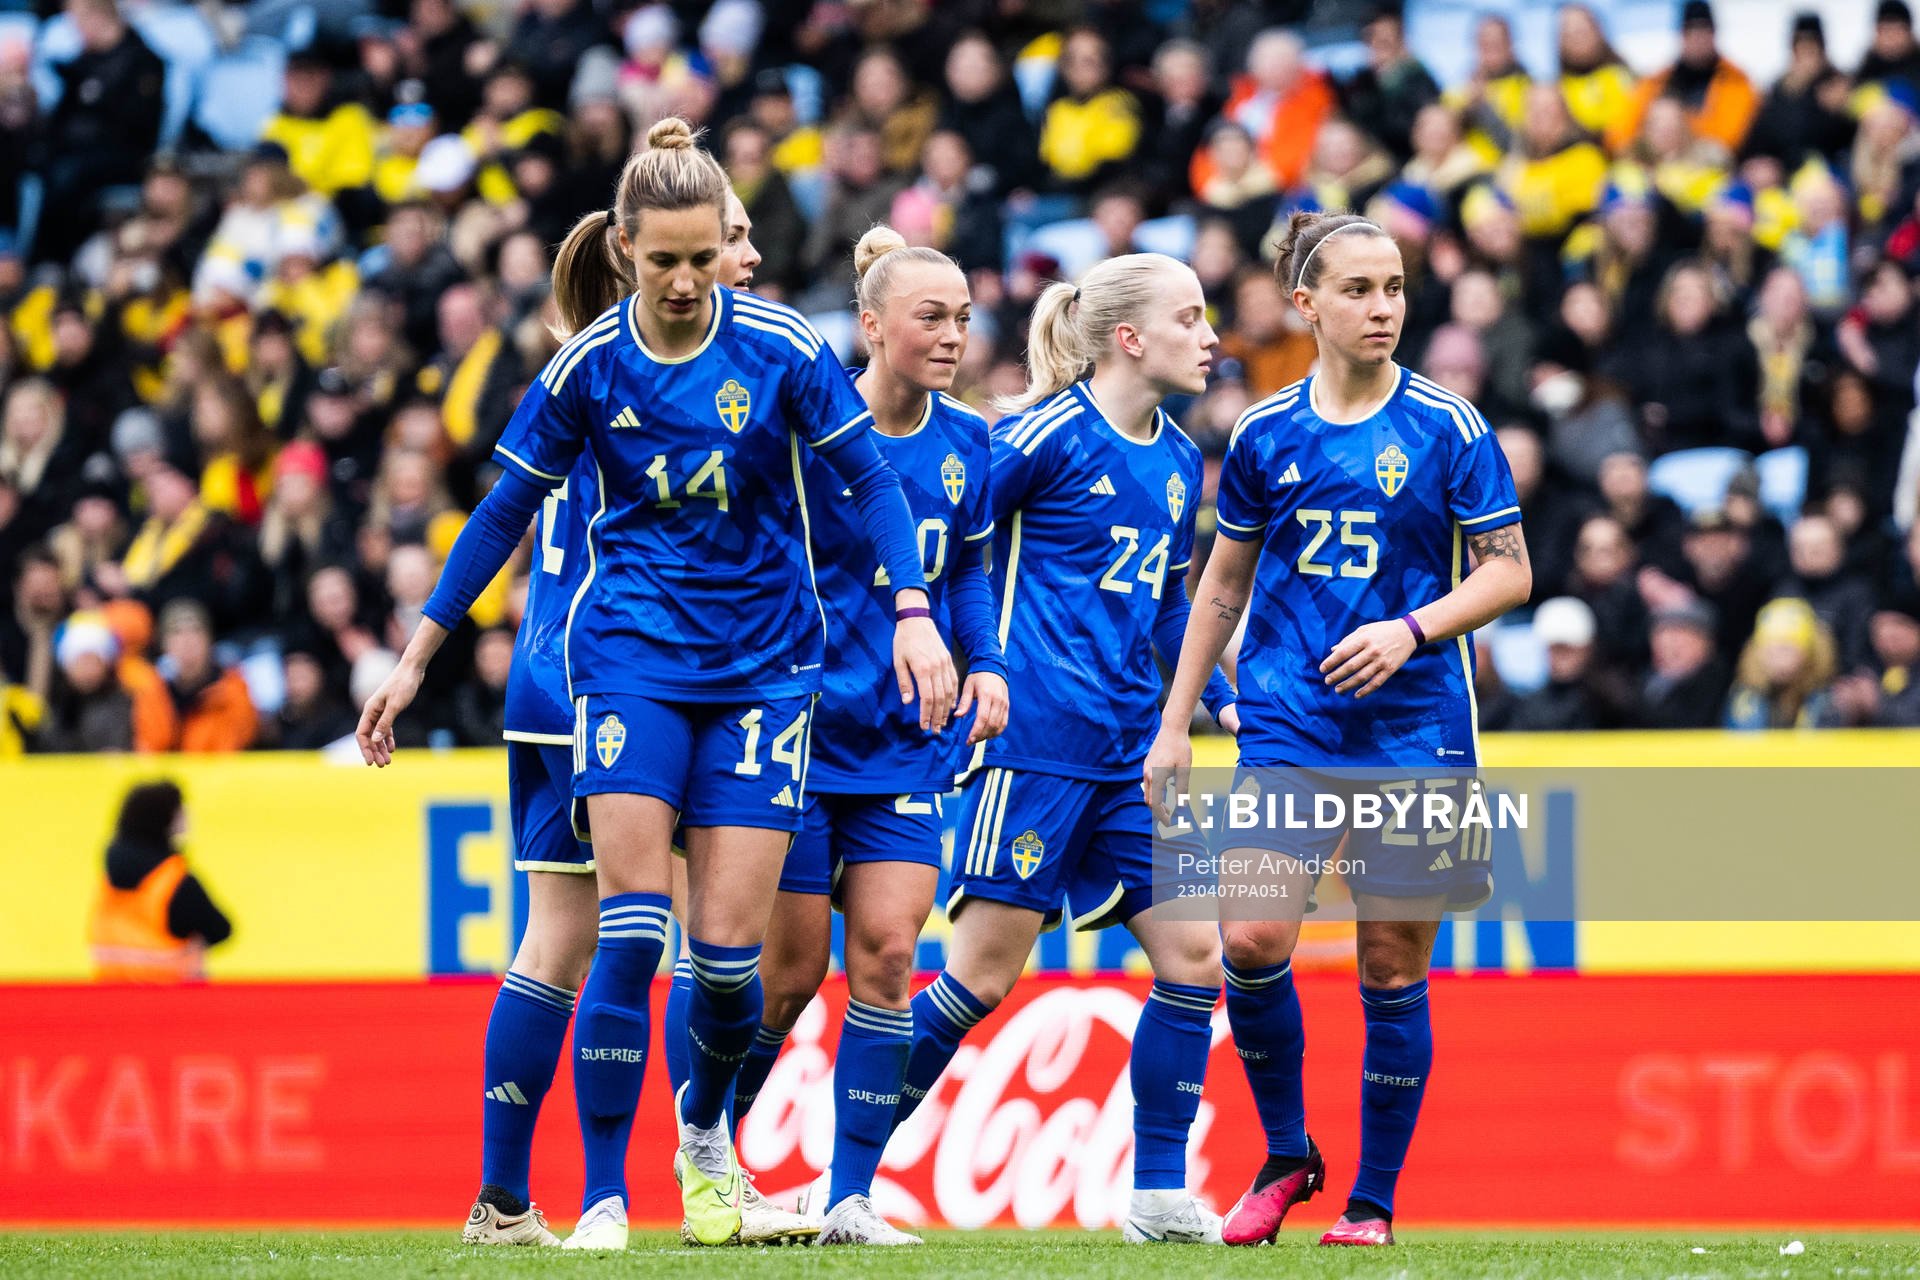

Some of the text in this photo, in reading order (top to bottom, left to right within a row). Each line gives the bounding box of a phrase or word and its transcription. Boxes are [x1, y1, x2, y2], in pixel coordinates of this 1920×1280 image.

[645, 450, 729, 513] 14
[873, 518, 948, 587] 0
[1099, 525, 1170, 600] 24
[1296, 508, 1379, 579] 25
[734, 708, 807, 781] 14
[1378, 777, 1459, 846] 25
[848, 1088, 901, 1105] SVERIG
